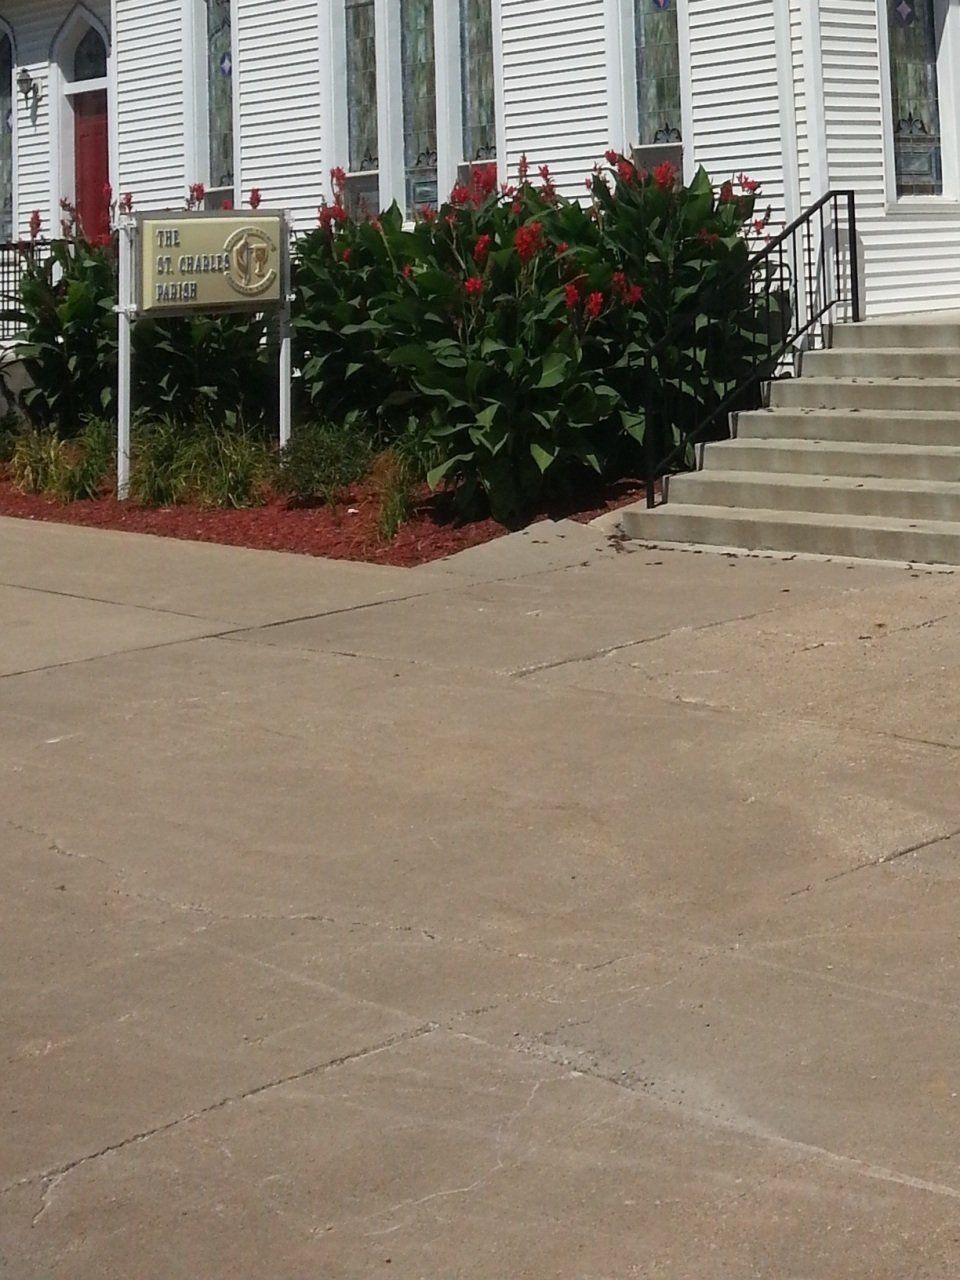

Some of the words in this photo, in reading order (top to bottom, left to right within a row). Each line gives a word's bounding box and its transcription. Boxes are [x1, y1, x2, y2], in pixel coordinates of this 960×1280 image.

[156, 229, 180, 248] THE
[156, 255, 174, 276] ST.
[156, 281, 198, 302] PARISH
